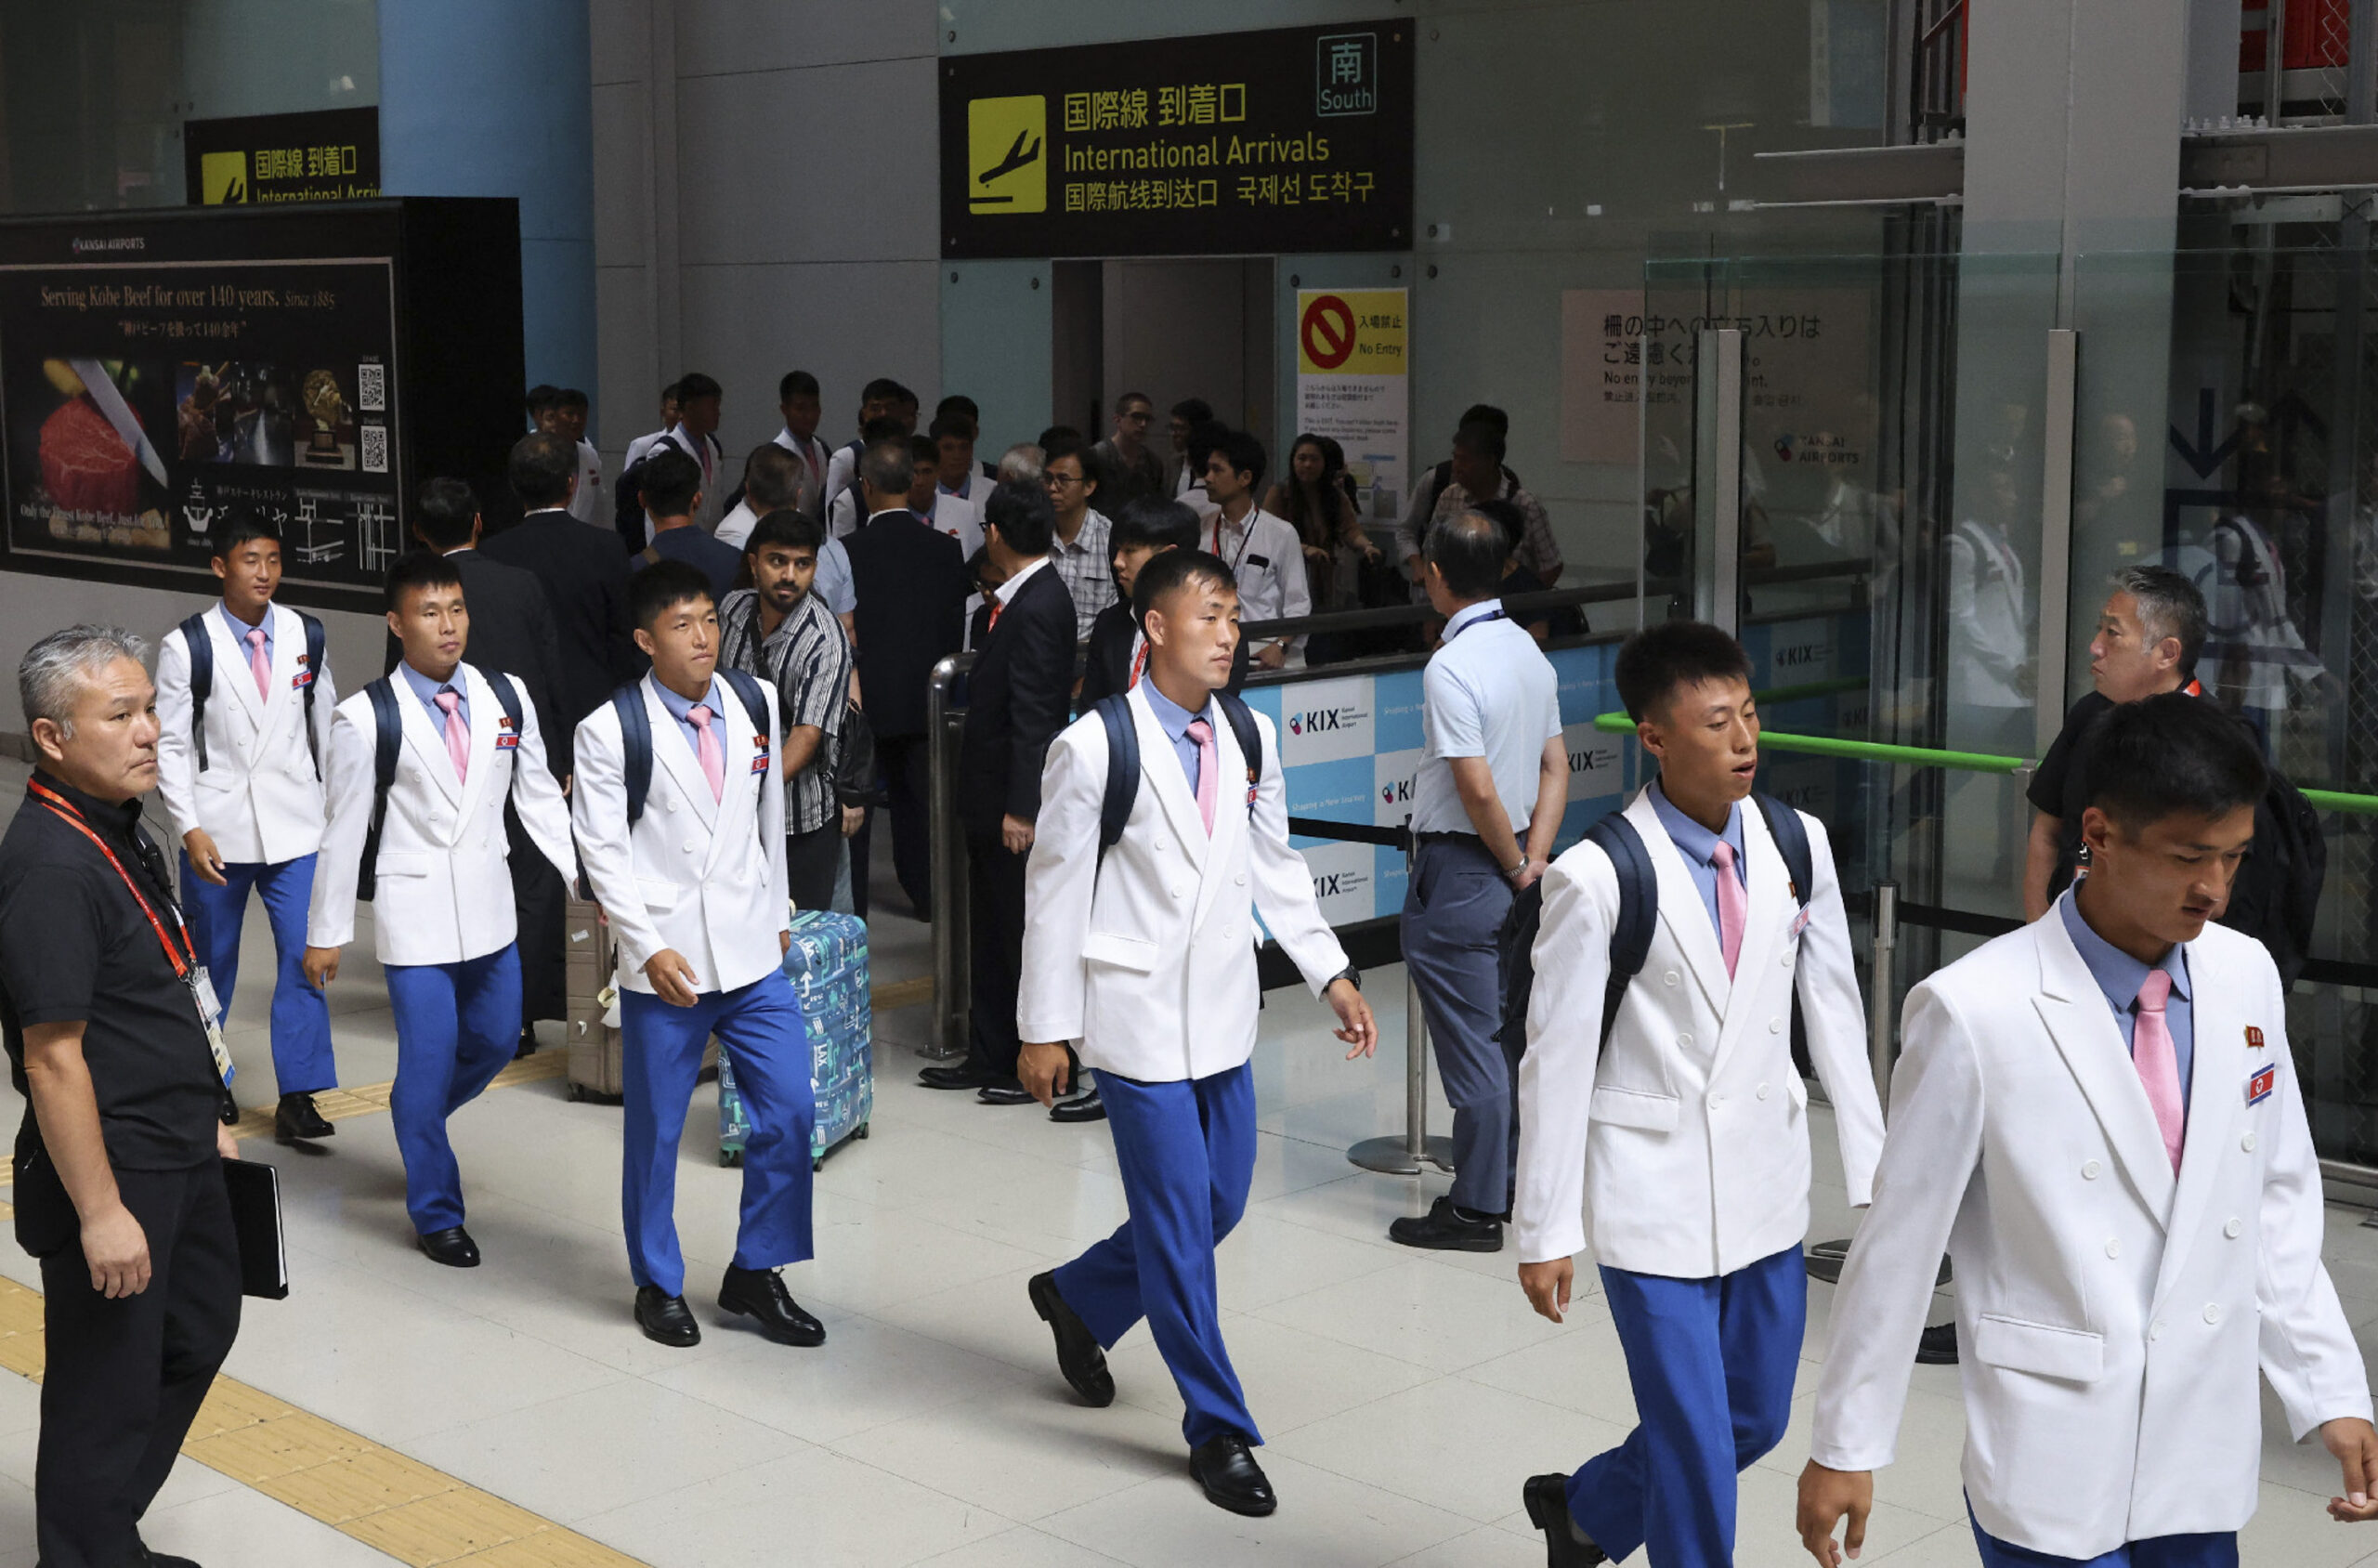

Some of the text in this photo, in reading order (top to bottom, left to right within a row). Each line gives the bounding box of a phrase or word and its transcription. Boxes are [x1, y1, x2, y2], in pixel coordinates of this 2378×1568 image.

[1331, 43, 1363, 85] 南
[1065, 82, 1246, 132] 国際線 到着口
[1320, 87, 1372, 111] South
[255, 145, 357, 180] 国際線 到着口
[1065, 130, 1330, 173] International Arrivals
[256, 182, 382, 203] International Arriv
[1236, 171, 1376, 206] 국제선 도착구
[80, 237, 145, 251] KANSAI AIRPORTS
[41, 284, 335, 312] Serving Kobe Beef for over 140 years. Since 1885
[1360, 316, 1402, 329] 入場禁止
[1360, 344, 1402, 357] No Entry
[1604, 372, 1621, 384] No
[1624, 373, 1656, 388] eny
[1788, 646, 1812, 665] KIX
[1307, 709, 1339, 732] KIX
[1854, 707, 1869, 725] KI
[1292, 801, 1318, 811] Shaping
[817, 1043, 828, 1067] LAX
